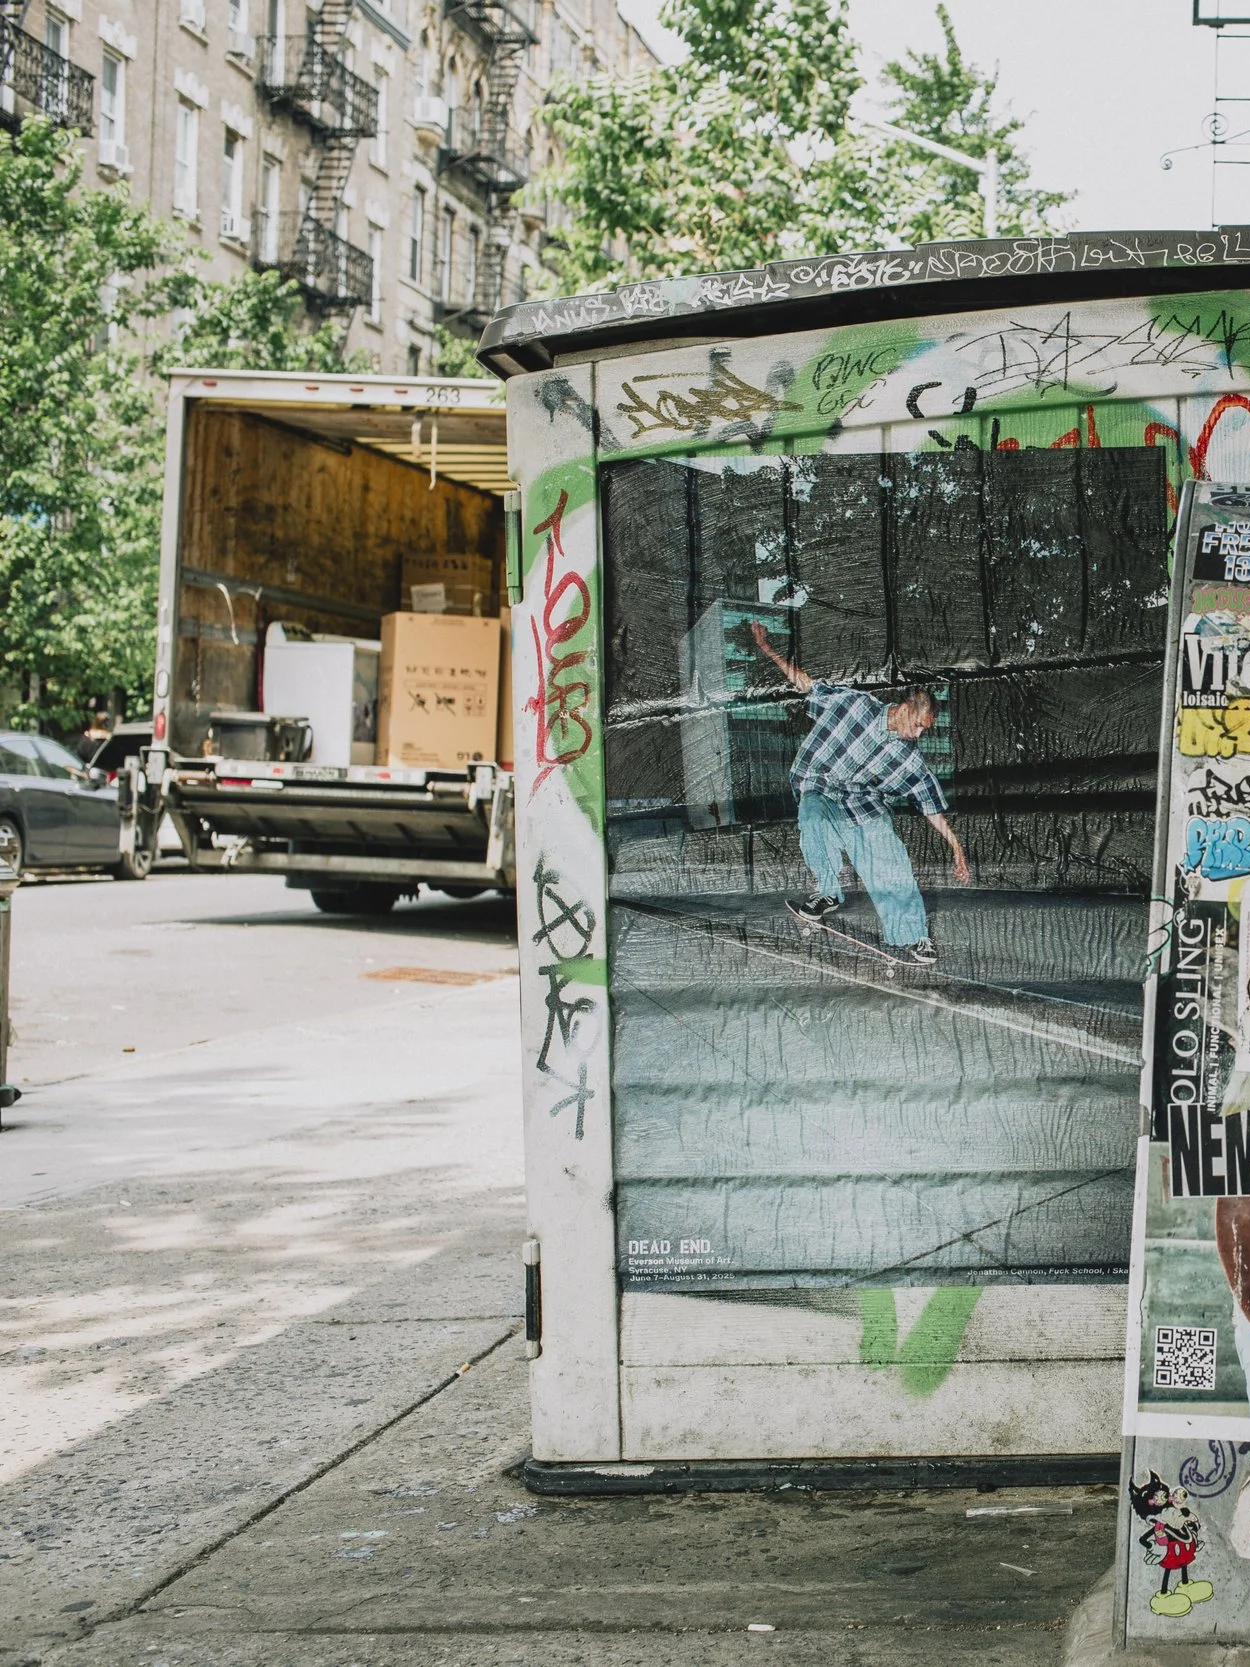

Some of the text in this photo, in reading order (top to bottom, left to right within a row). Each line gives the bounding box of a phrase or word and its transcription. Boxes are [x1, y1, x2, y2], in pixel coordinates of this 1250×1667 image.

[426, 387, 460, 403] 263
[1170, 917, 1205, 1105] OLO SLING
[1206, 928, 1224, 1112] INIMAL FUNCTIONAL UNISEX
[628, 1239, 715, 1255] DEAD END.
[666, 1257, 703, 1265] Museum
[628, 1266, 672, 1275] Syracuse,
[1010, 1267, 1047, 1276] Cannon,
[1049, 1267, 1070, 1275] Fuck
[1072, 1267, 1105, 1275] School,
[629, 1274, 651, 1282] June
[697, 1273, 710, 1281] 31,
